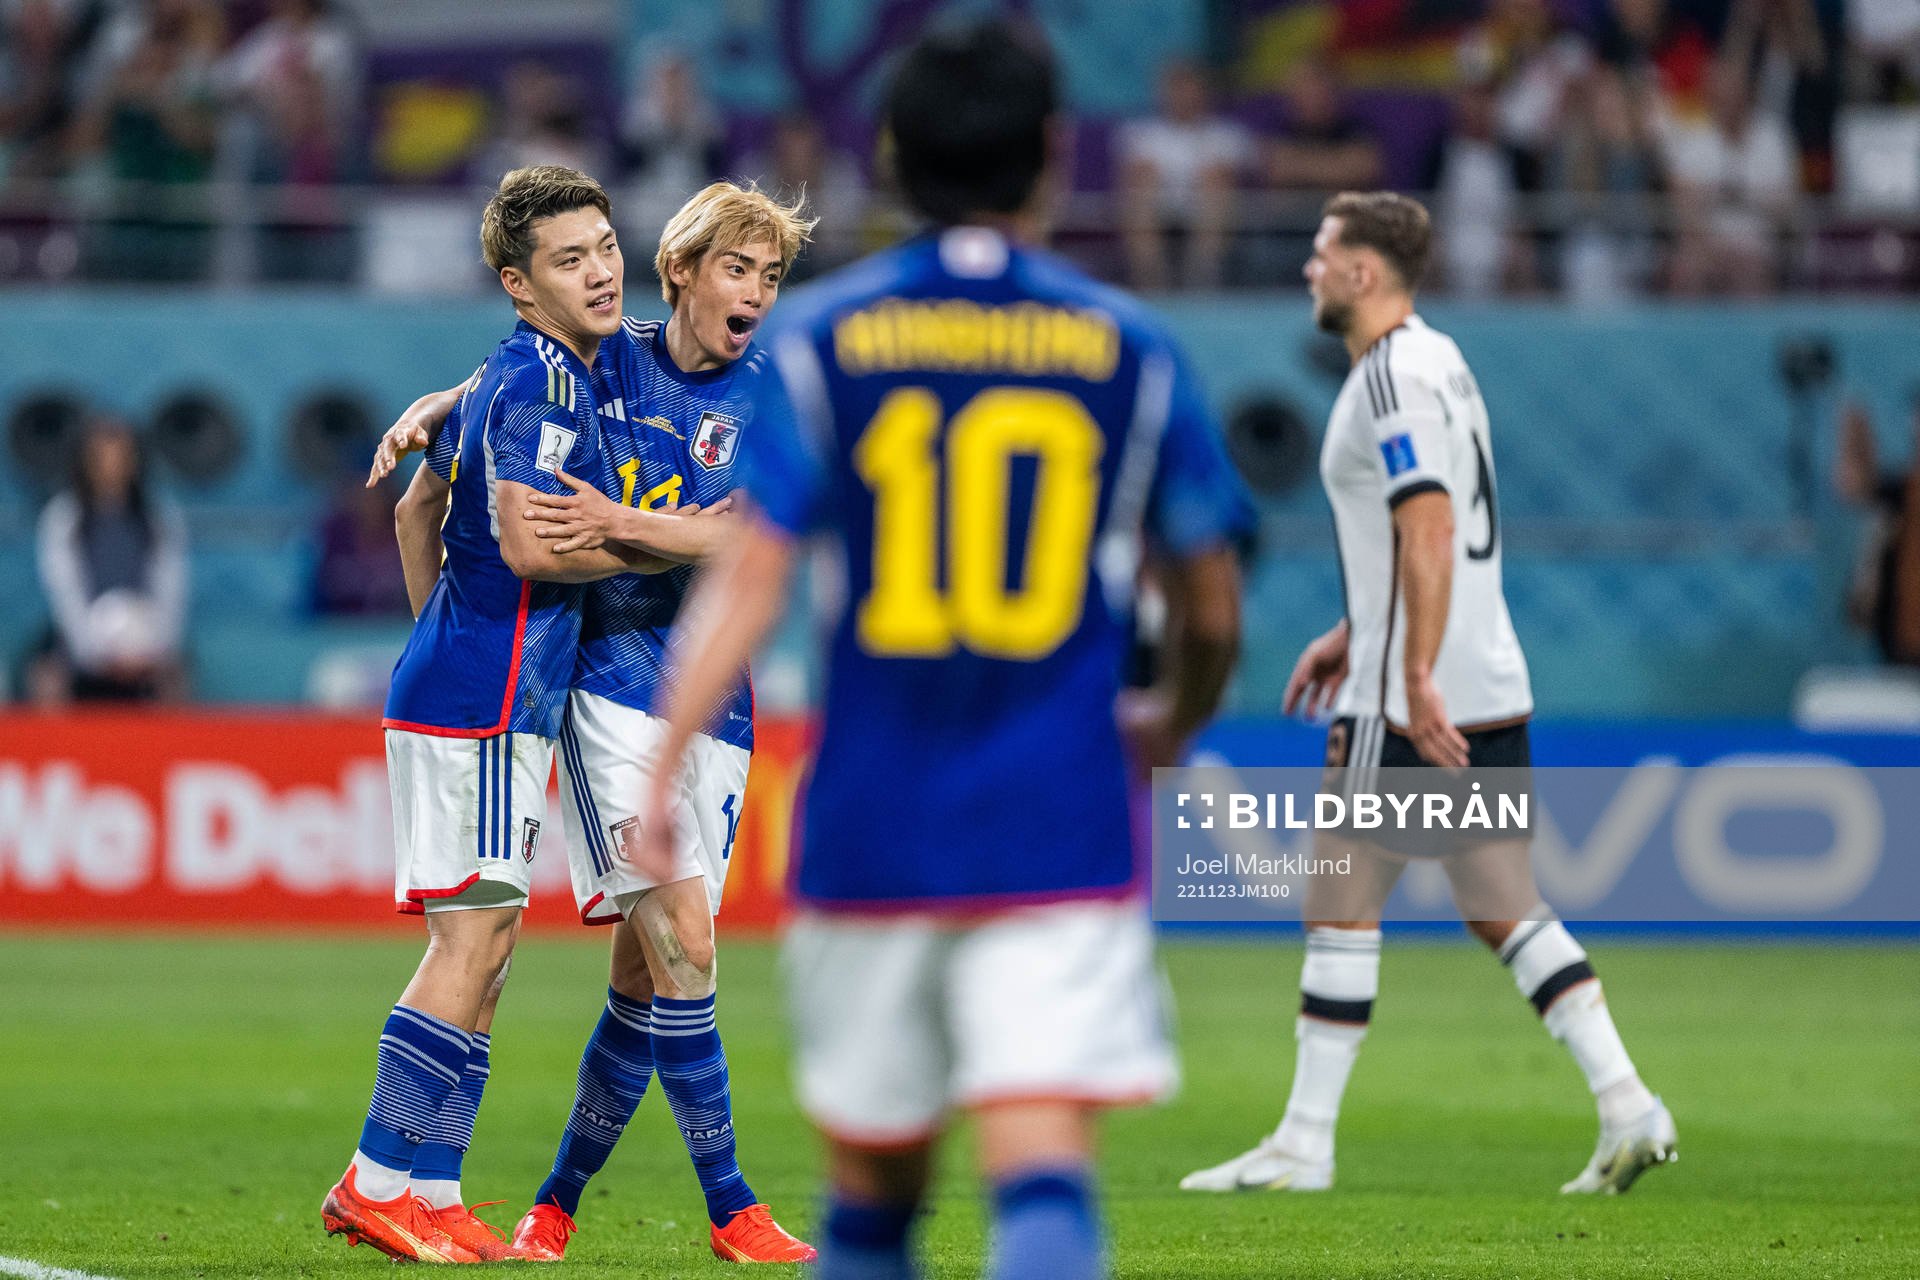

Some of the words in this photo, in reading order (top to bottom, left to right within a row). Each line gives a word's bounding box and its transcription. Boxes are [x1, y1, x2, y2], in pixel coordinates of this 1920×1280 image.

[711, 414, 734, 424] JAPAN
[700, 449, 721, 463] JFA
[856, 390, 1103, 658] 10
